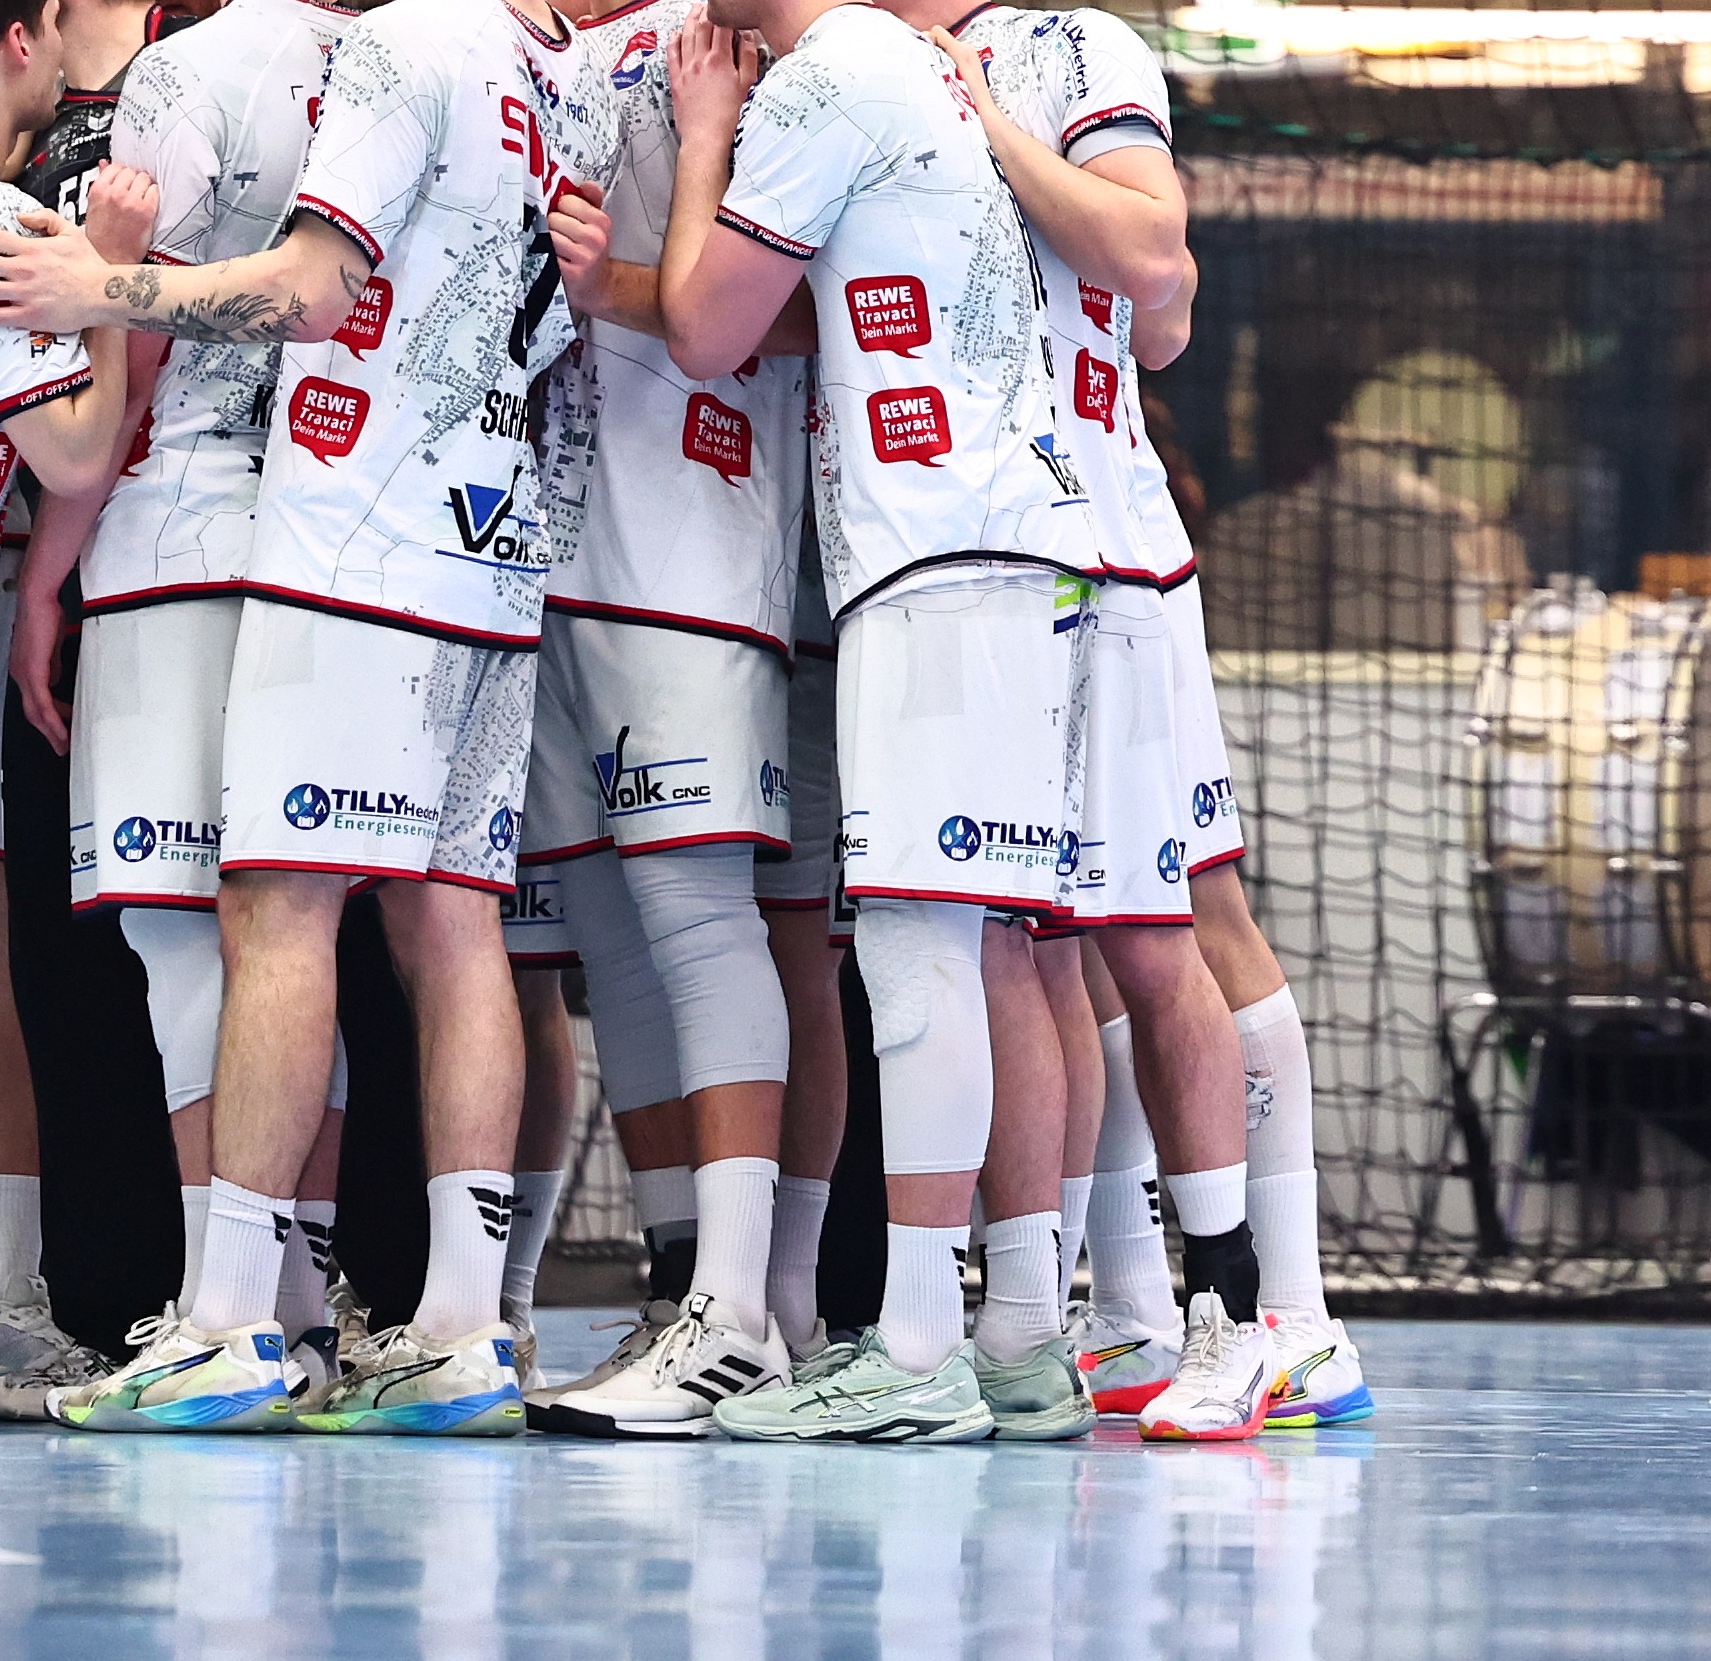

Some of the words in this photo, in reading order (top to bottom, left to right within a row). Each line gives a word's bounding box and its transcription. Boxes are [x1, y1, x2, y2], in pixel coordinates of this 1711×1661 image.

[854, 286, 914, 310] REWE
[858, 304, 916, 326] Travaci
[861, 326, 883, 340] Dein
[885, 322, 918, 337] Markt
[20, 388, 43, 407] LOFT
[305, 389, 357, 416] REWE
[879, 397, 933, 421] REWE
[300, 407, 355, 432] Travaci
[699, 404, 742, 437] REWE
[883, 415, 936, 436] Travaci
[292, 420, 316, 437] Dein
[316, 429, 347, 445] Markt
[885, 436, 907, 451] Dein
[908, 432, 940, 447] Markt
[593, 725, 667, 810] Volk
[673, 785, 711, 799] CNC
